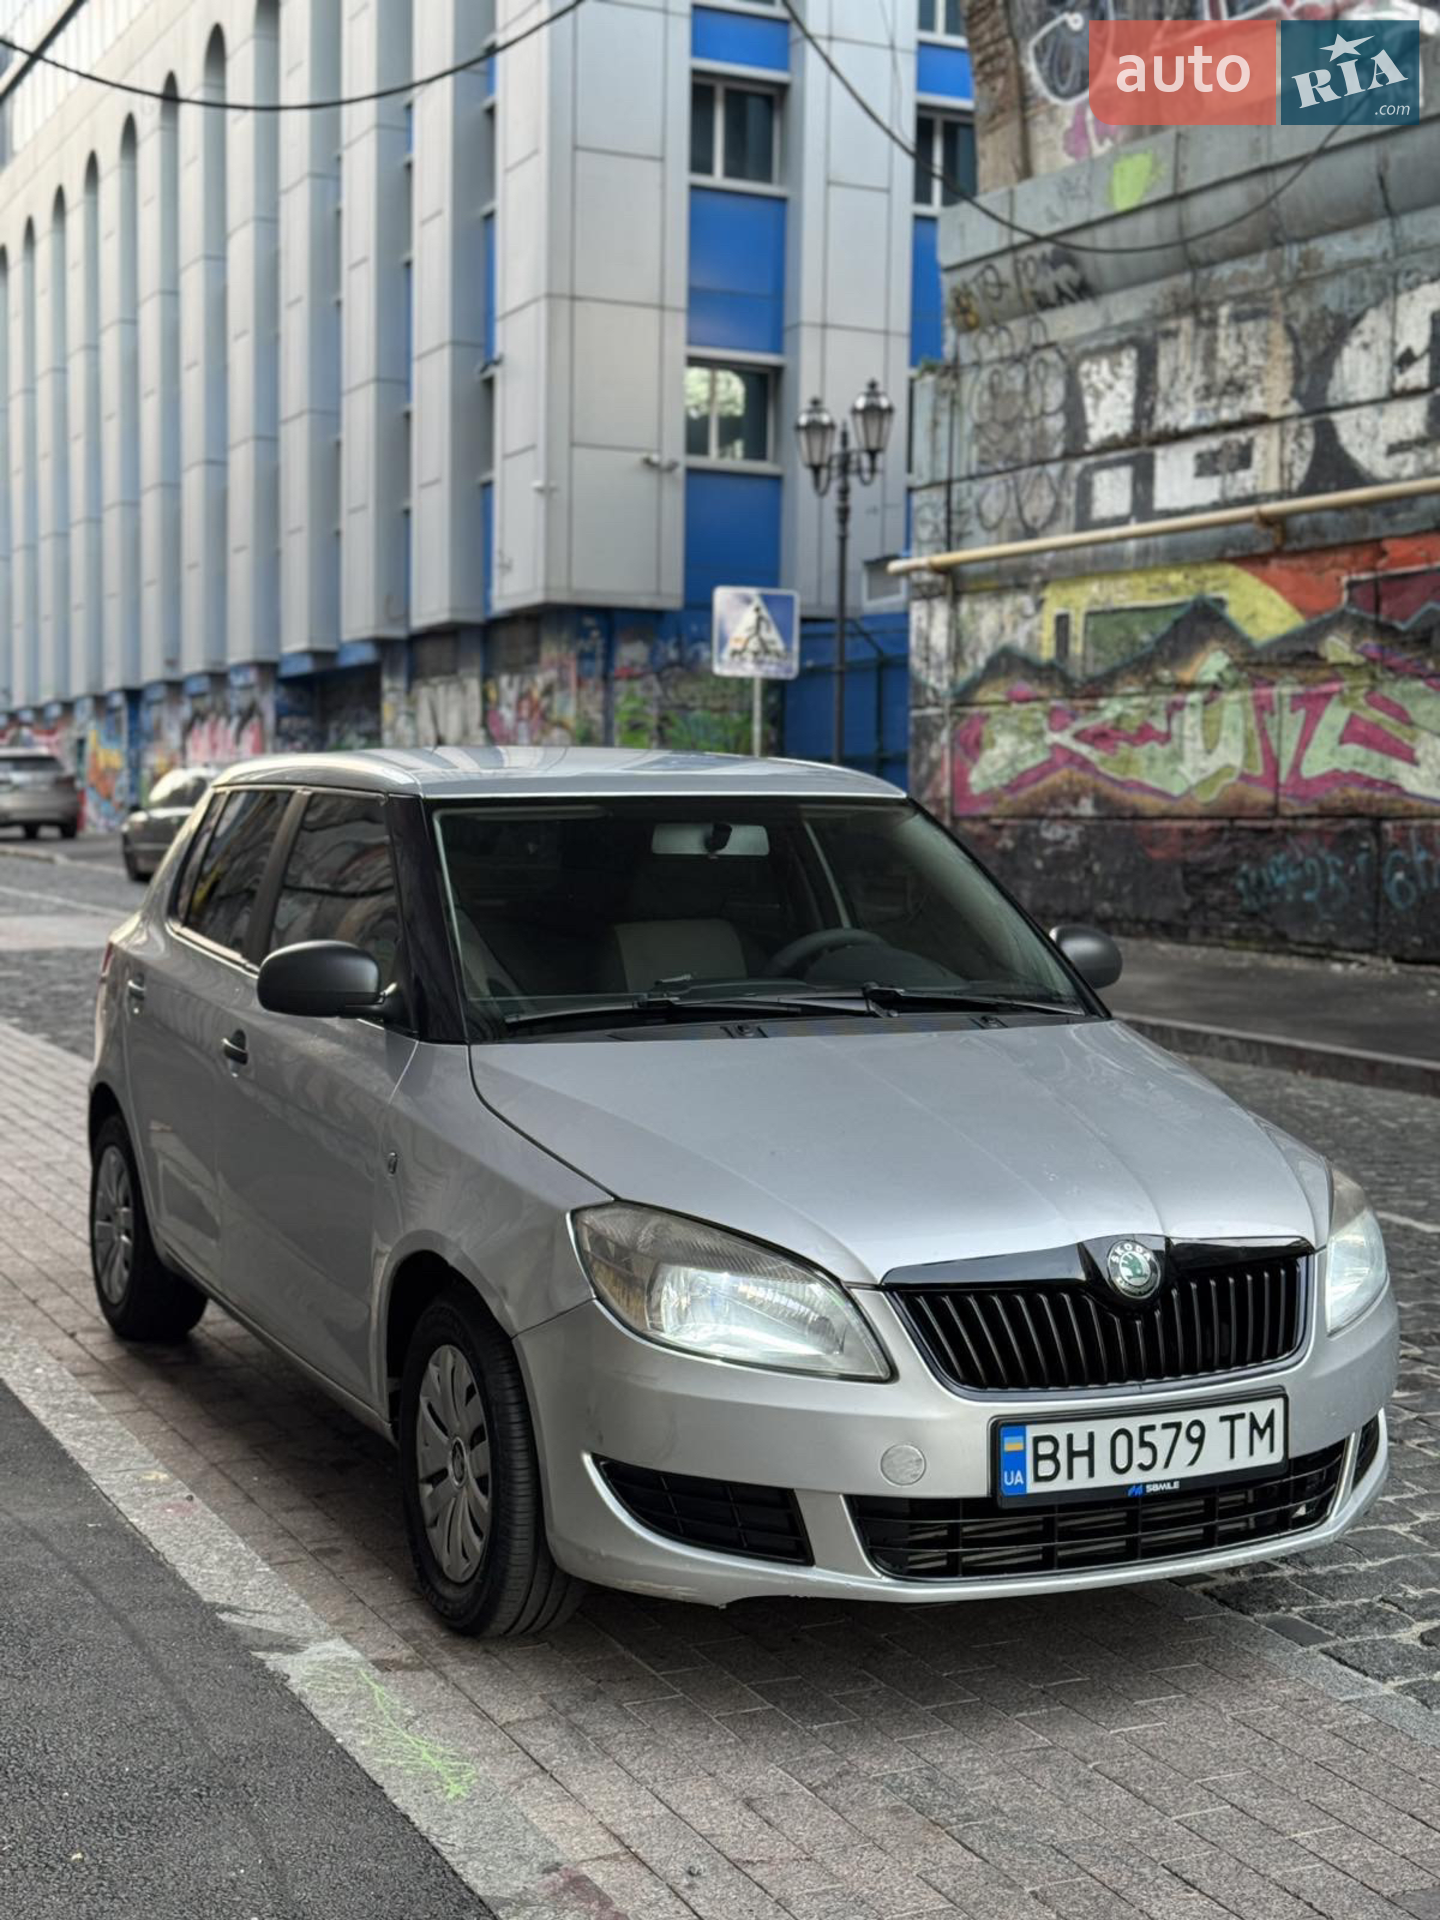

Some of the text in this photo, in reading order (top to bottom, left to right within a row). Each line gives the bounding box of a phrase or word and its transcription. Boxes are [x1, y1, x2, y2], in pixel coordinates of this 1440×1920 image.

[1032, 1408, 1275, 1483] BH 0579 TM
[1004, 1471, 1024, 1485] UA
